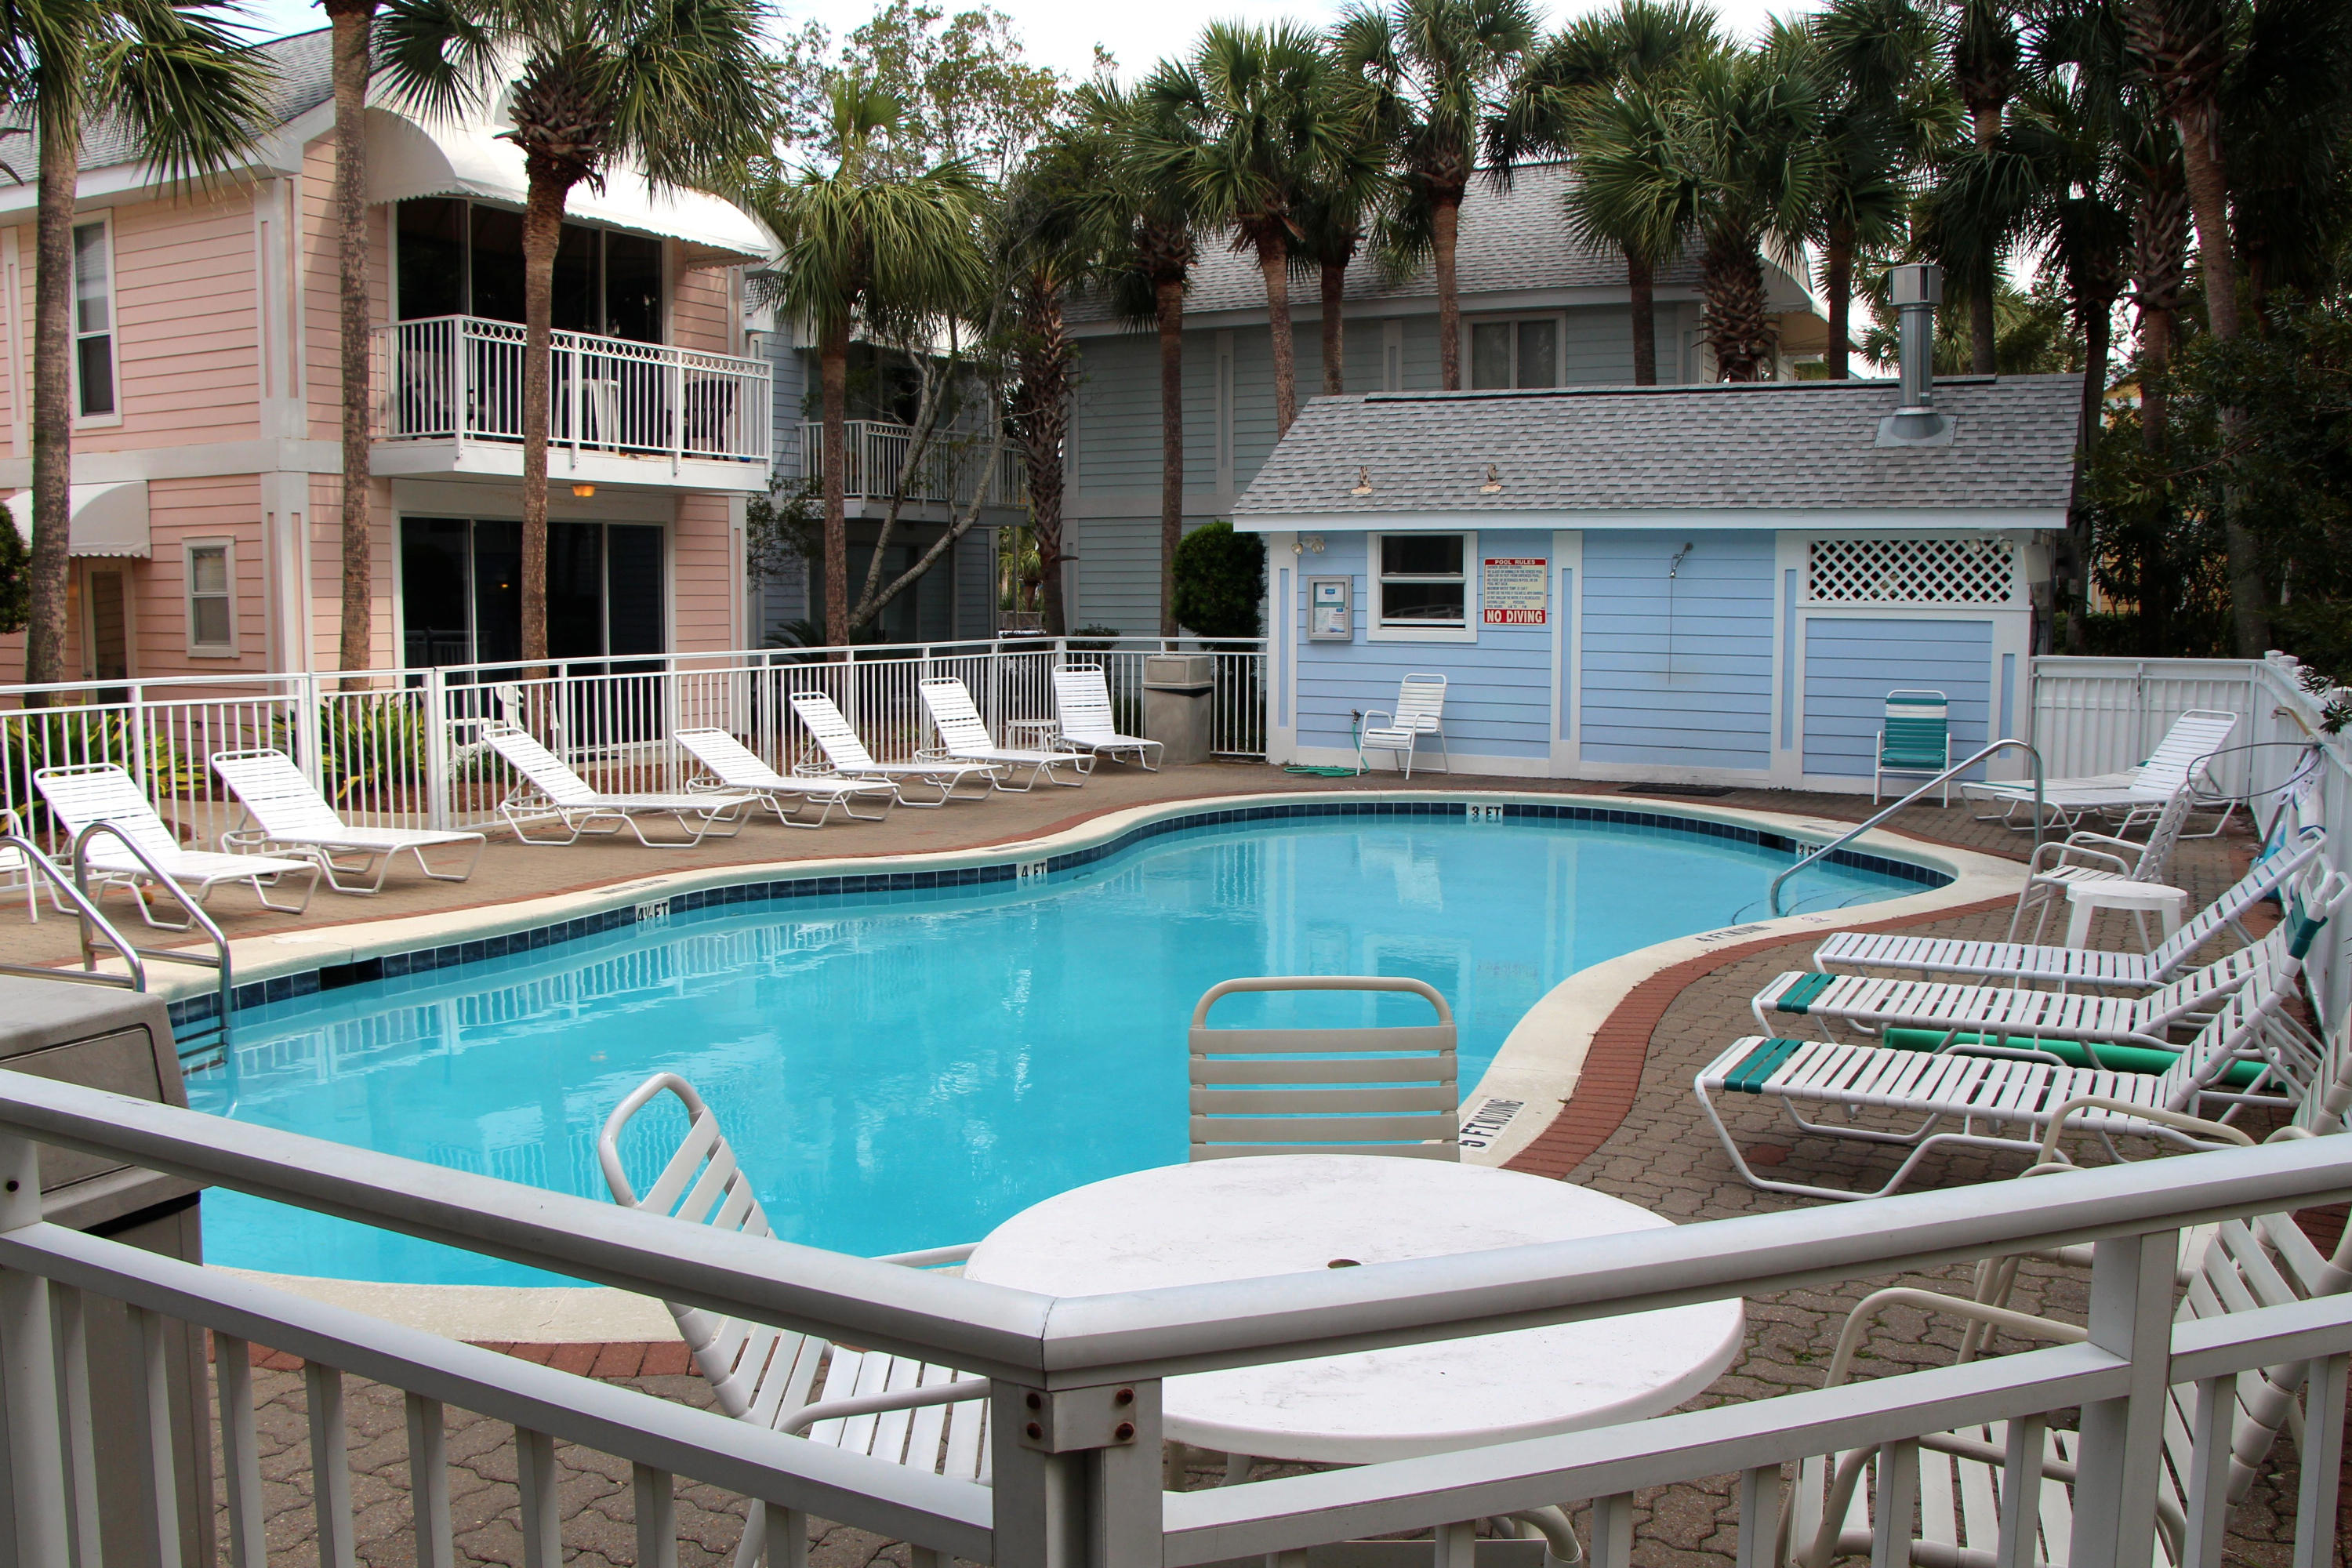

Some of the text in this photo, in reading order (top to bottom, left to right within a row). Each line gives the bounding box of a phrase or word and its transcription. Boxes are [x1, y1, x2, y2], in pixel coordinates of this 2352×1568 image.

[1486, 610, 1543, 622] NO DIVING
[1472, 806, 1501, 815] 3 FT
[1022, 862, 1046, 877] 4 FT
[654, 902, 668, 918] FT
